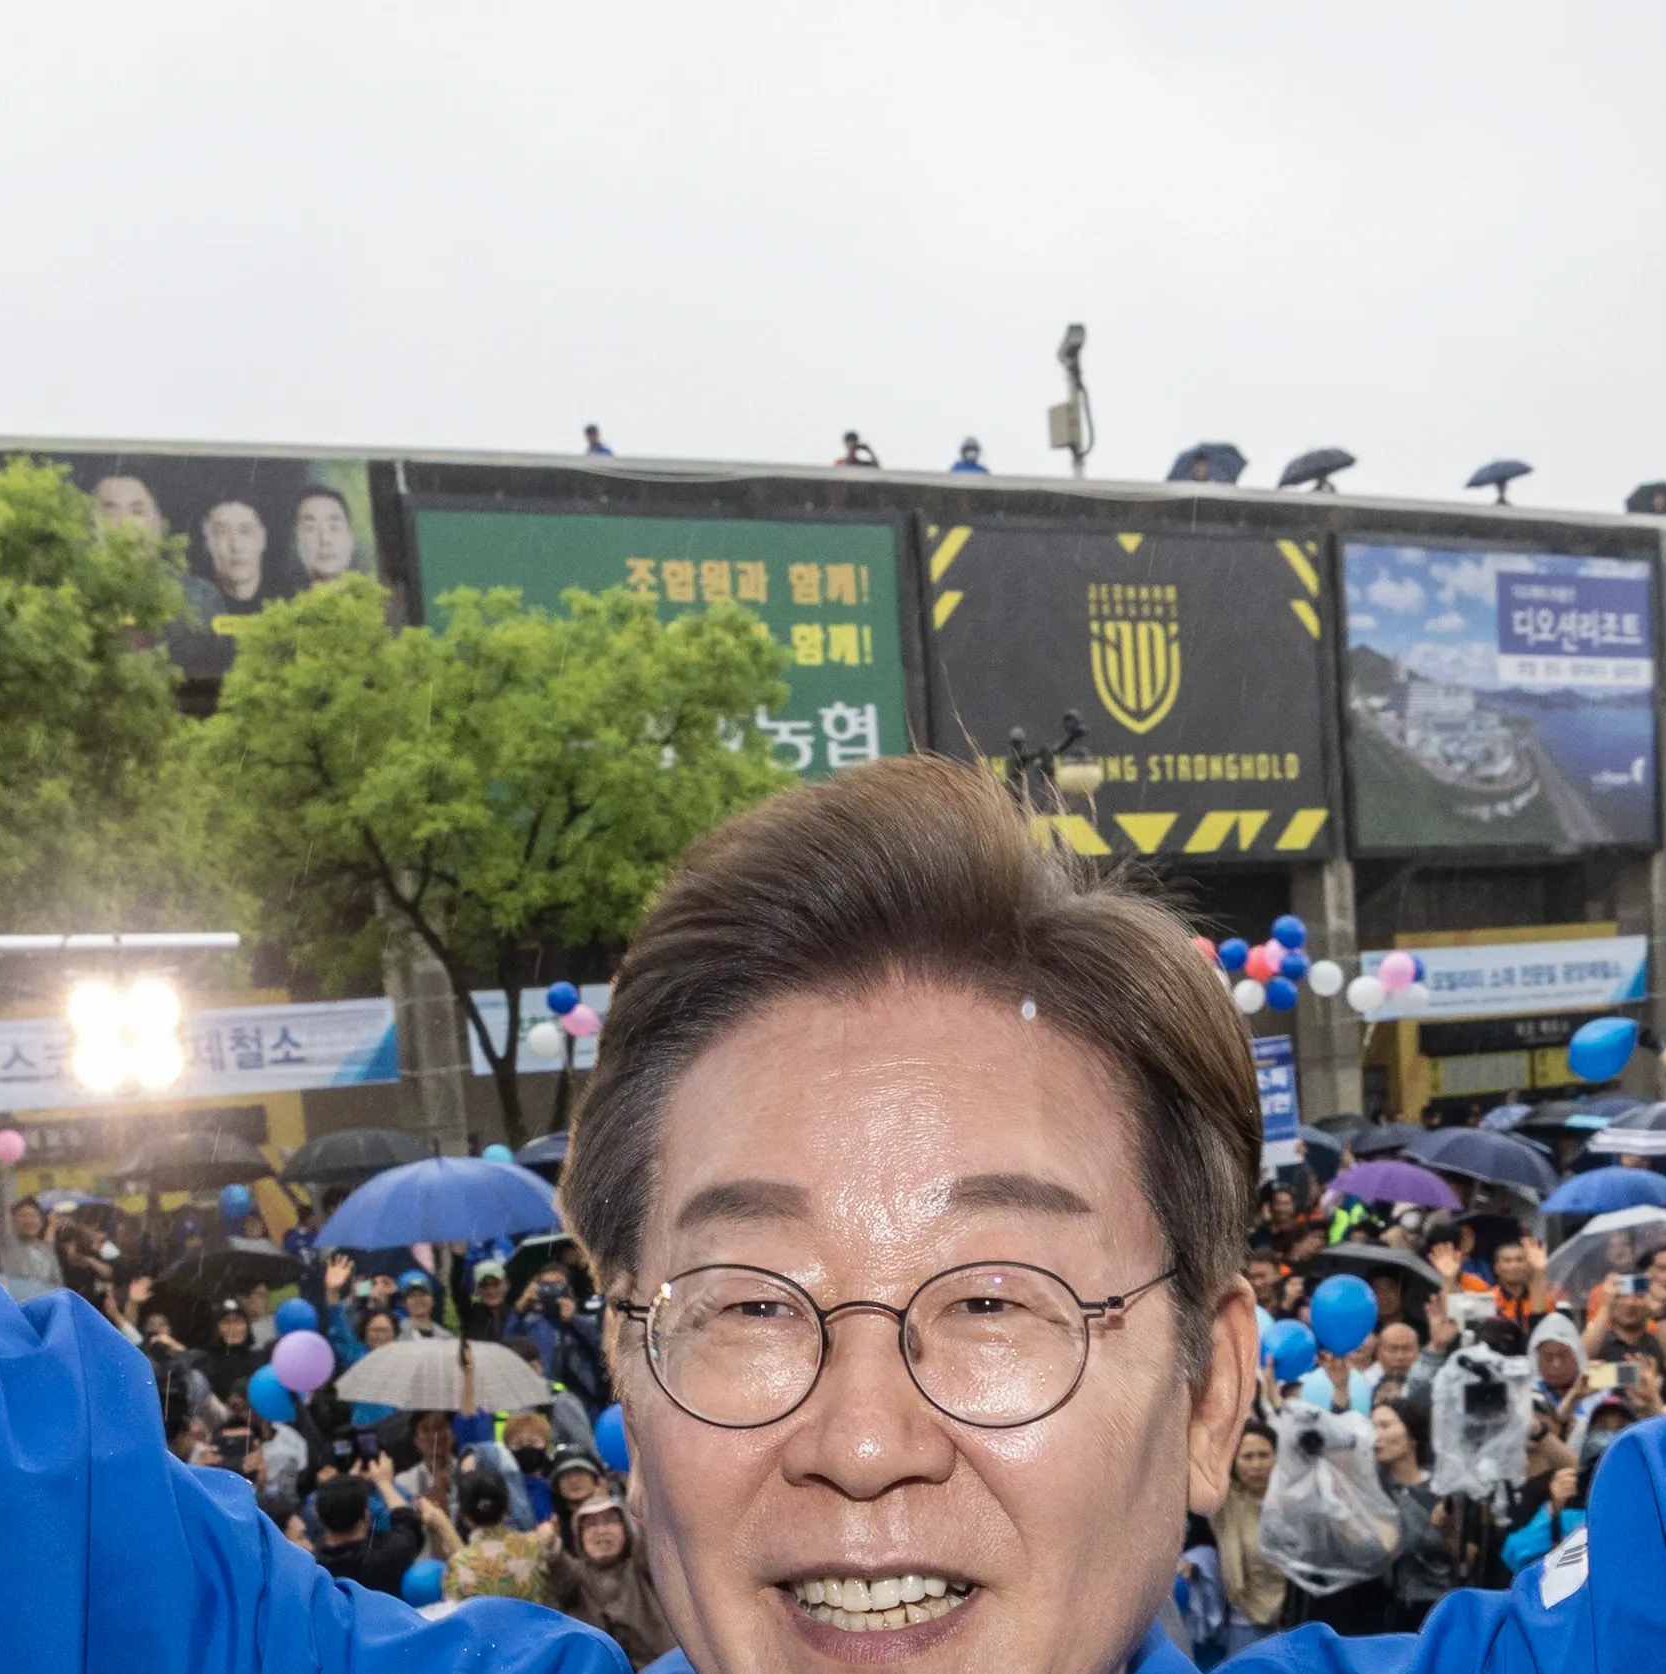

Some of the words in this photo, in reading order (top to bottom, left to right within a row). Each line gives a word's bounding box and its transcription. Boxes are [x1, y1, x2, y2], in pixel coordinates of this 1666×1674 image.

[625, 557, 769, 604] 조합원과
[788, 562, 869, 606] 함께!
[790, 622, 873, 667] 함께!
[1510, 606, 1644, 653] 디오션리조트
[1147, 752, 1300, 783] STRONGHOLD
